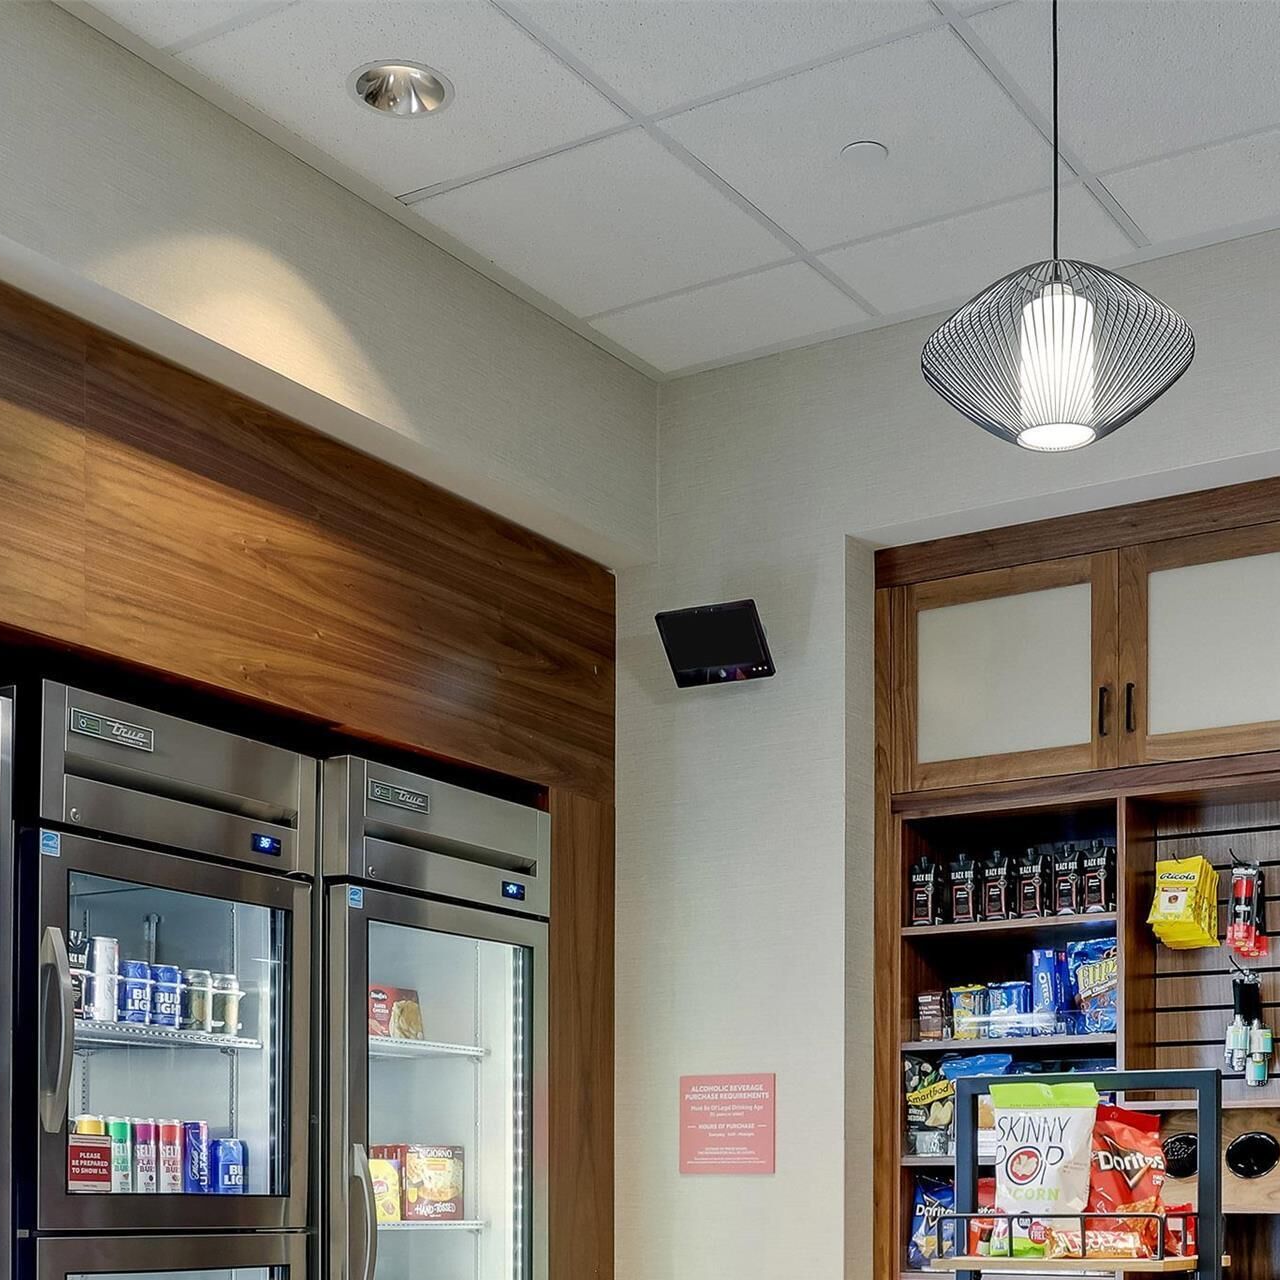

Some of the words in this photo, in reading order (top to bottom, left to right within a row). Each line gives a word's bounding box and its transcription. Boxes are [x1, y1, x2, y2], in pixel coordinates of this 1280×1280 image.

[1160, 872, 1196, 881] Ricola
[132, 989, 149, 1000] BU
[156, 993, 180, 1004] BUD
[128, 1000, 149, 1011] LIG
[720, 1092, 769, 1100] REQUIREMENTS
[997, 1116, 1072, 1143] SKINNY
[199, 1143, 208, 1185] ULTRA
[995, 1145, 1064, 1185] POP
[1099, 1151, 1165, 1171] Doritos
[229, 1164, 242, 1175] BU
[224, 1174, 242, 1184] LIG
